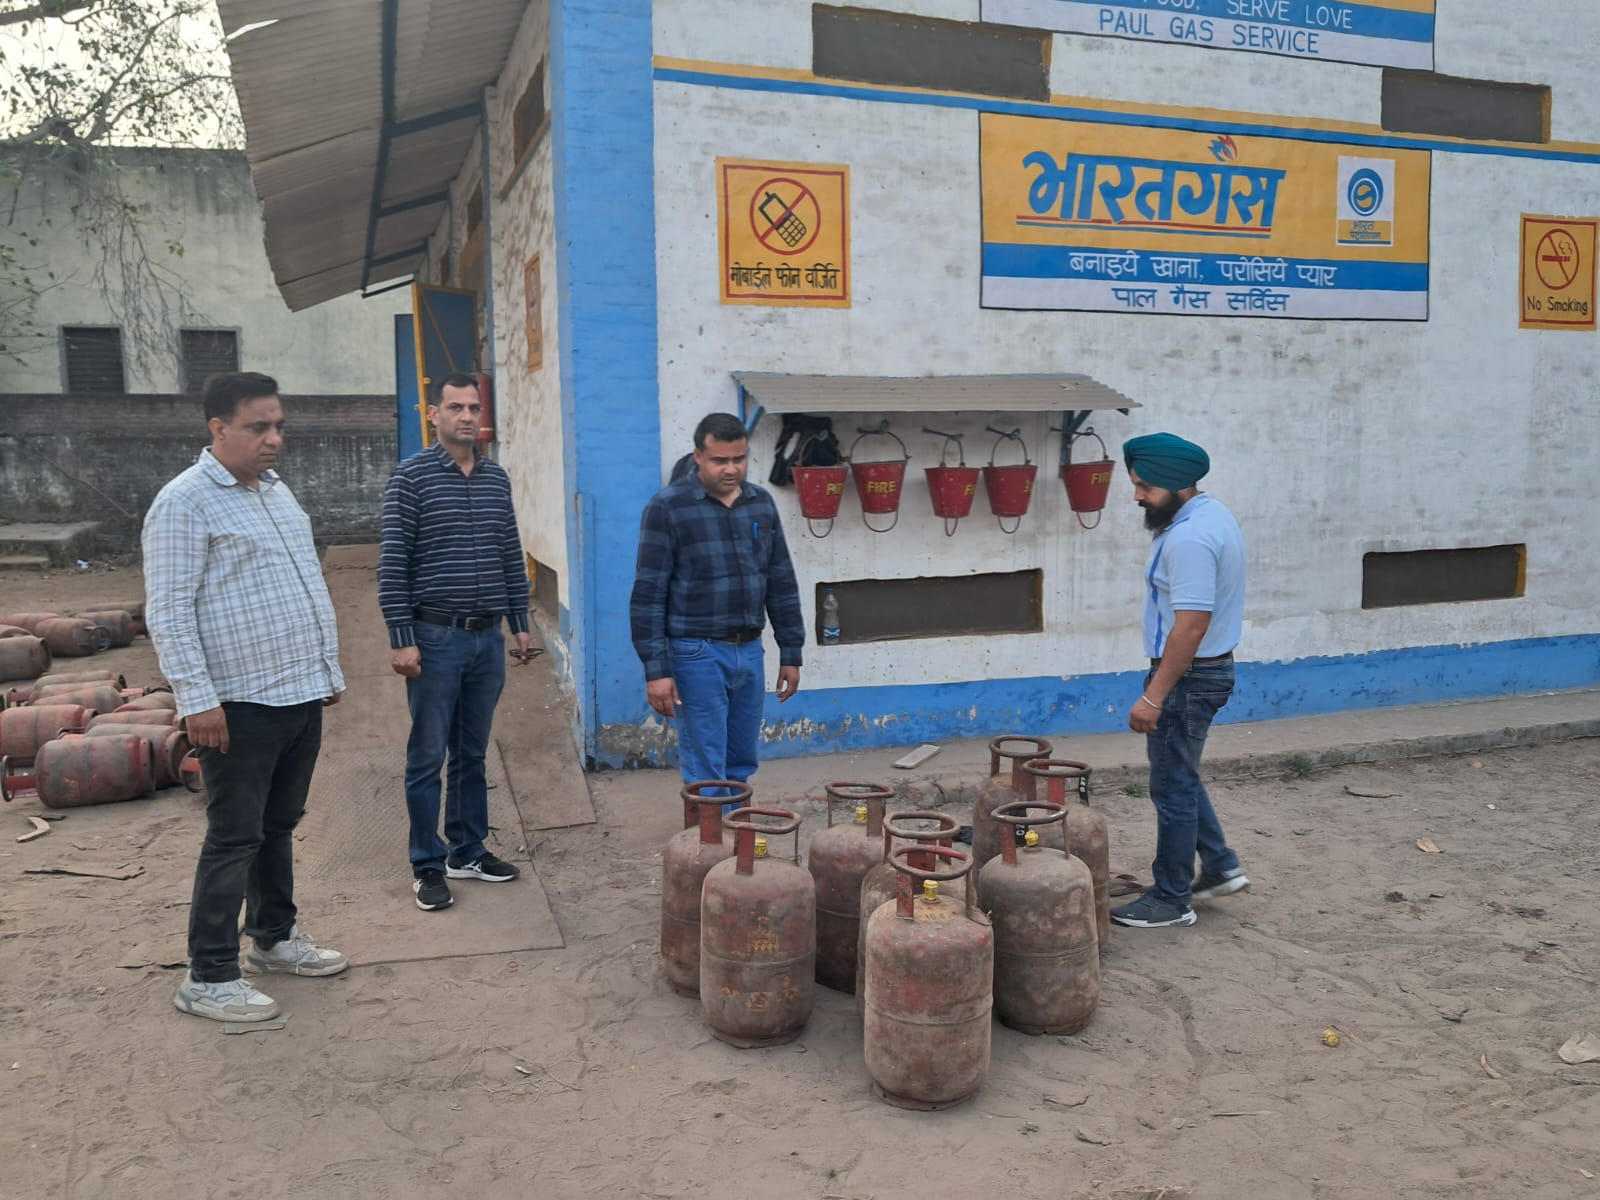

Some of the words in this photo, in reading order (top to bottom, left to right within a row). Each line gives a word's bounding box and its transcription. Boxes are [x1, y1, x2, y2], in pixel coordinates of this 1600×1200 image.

[1227, 0, 1291, 21] SERVE
[1305, 6, 1353, 29] LOVE
[1099, 8, 1154, 36] PAUL
[1170, 16, 1214, 42] GAS
[1232, 23, 1320, 53] SERVICE
[774, 262, 801, 288] फोन
[1068, 250, 1140, 279] बनाइये
[1149, 256, 1204, 281] खाना,
[1216, 256, 1288, 283] परोसिये
[1296, 264, 1338, 287] प्यार
[1111, 287, 1157, 308] पाल
[1169, 284, 1211, 309] गैस
[1226, 287, 1290, 312] सर्विस
[1527, 296, 1542, 311] No
[1547, 296, 1588, 315] Smoking
[866, 480, 896, 494] FIRE
